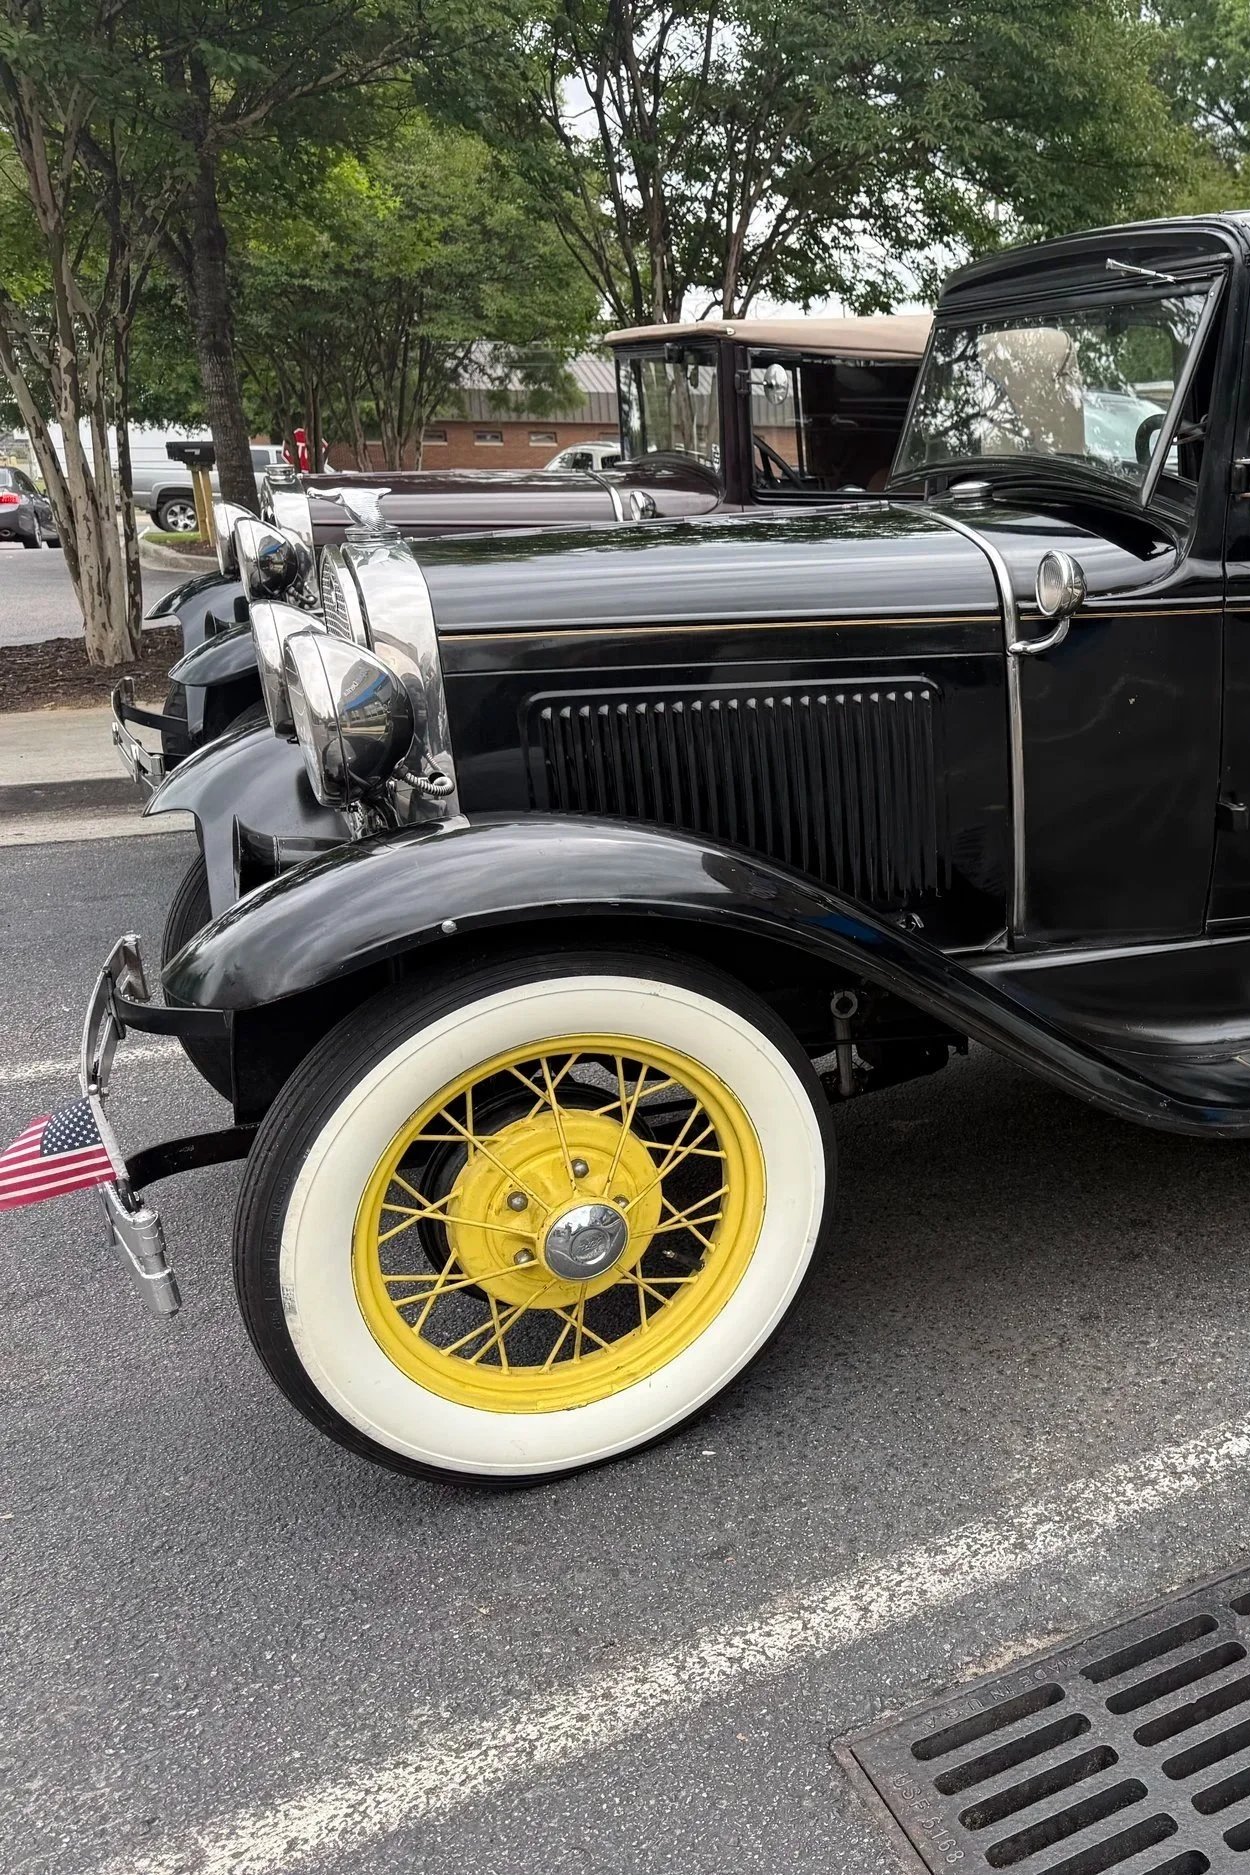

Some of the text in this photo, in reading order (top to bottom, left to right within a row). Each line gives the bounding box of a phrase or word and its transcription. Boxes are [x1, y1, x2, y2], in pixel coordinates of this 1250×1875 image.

[1019, 1655, 1080, 1688] MADE
[990, 1684, 1017, 1701] IN
[893, 1772, 931, 1809] USF
